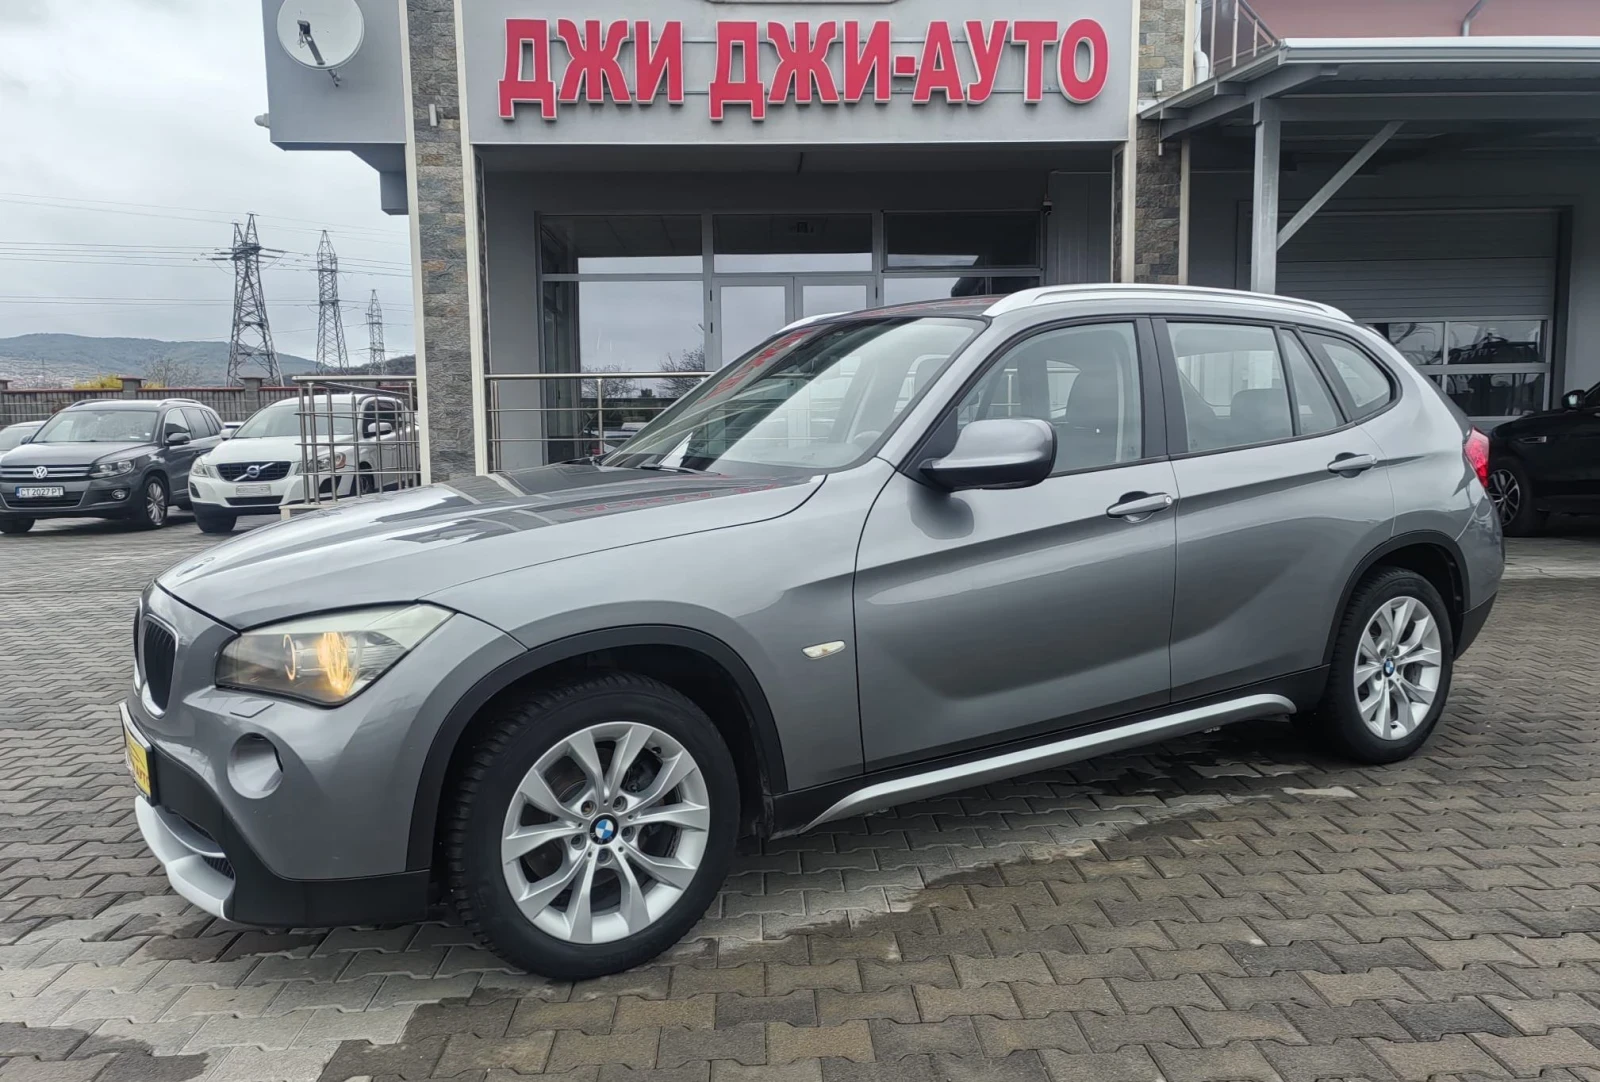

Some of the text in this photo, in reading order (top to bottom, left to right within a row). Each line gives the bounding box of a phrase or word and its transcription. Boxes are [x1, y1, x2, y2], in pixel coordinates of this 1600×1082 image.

[498, 18, 1110, 122] ДЖИ ДЖИ-АУТО
[20, 487, 62, 496] CT 2027 PT
